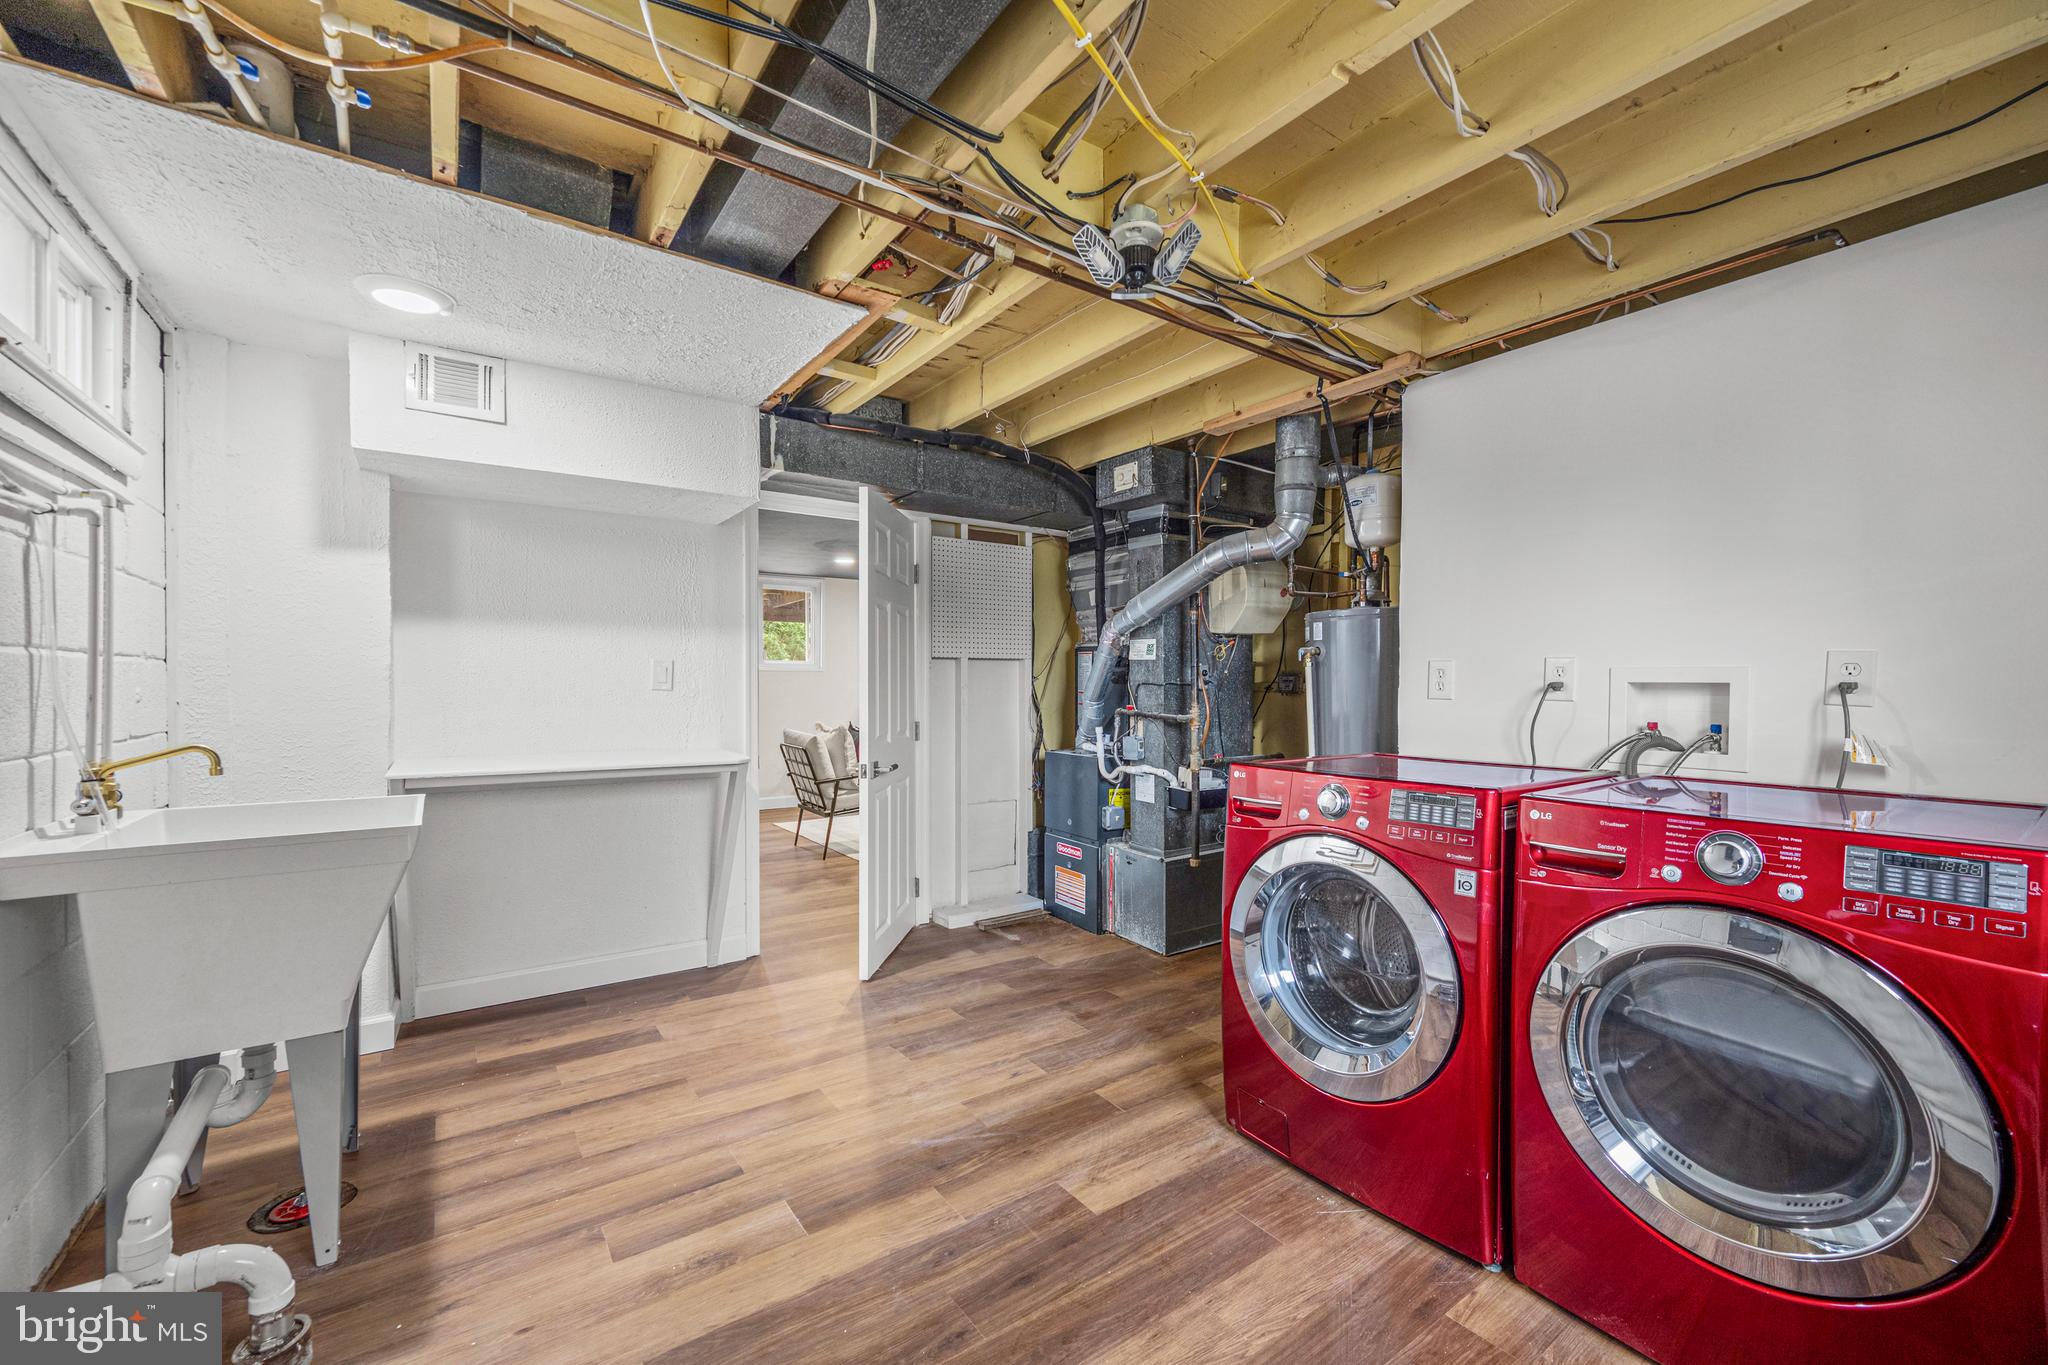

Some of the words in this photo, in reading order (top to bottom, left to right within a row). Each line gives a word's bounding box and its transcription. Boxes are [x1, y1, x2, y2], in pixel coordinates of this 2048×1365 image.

[1057, 844, 1082, 857] Goodman
[1597, 843, 1616, 851] Sensor
[1617, 845, 1627, 853] Dry
[1948, 919, 1959, 927] Dry
[1995, 923, 2015, 932] Signal
